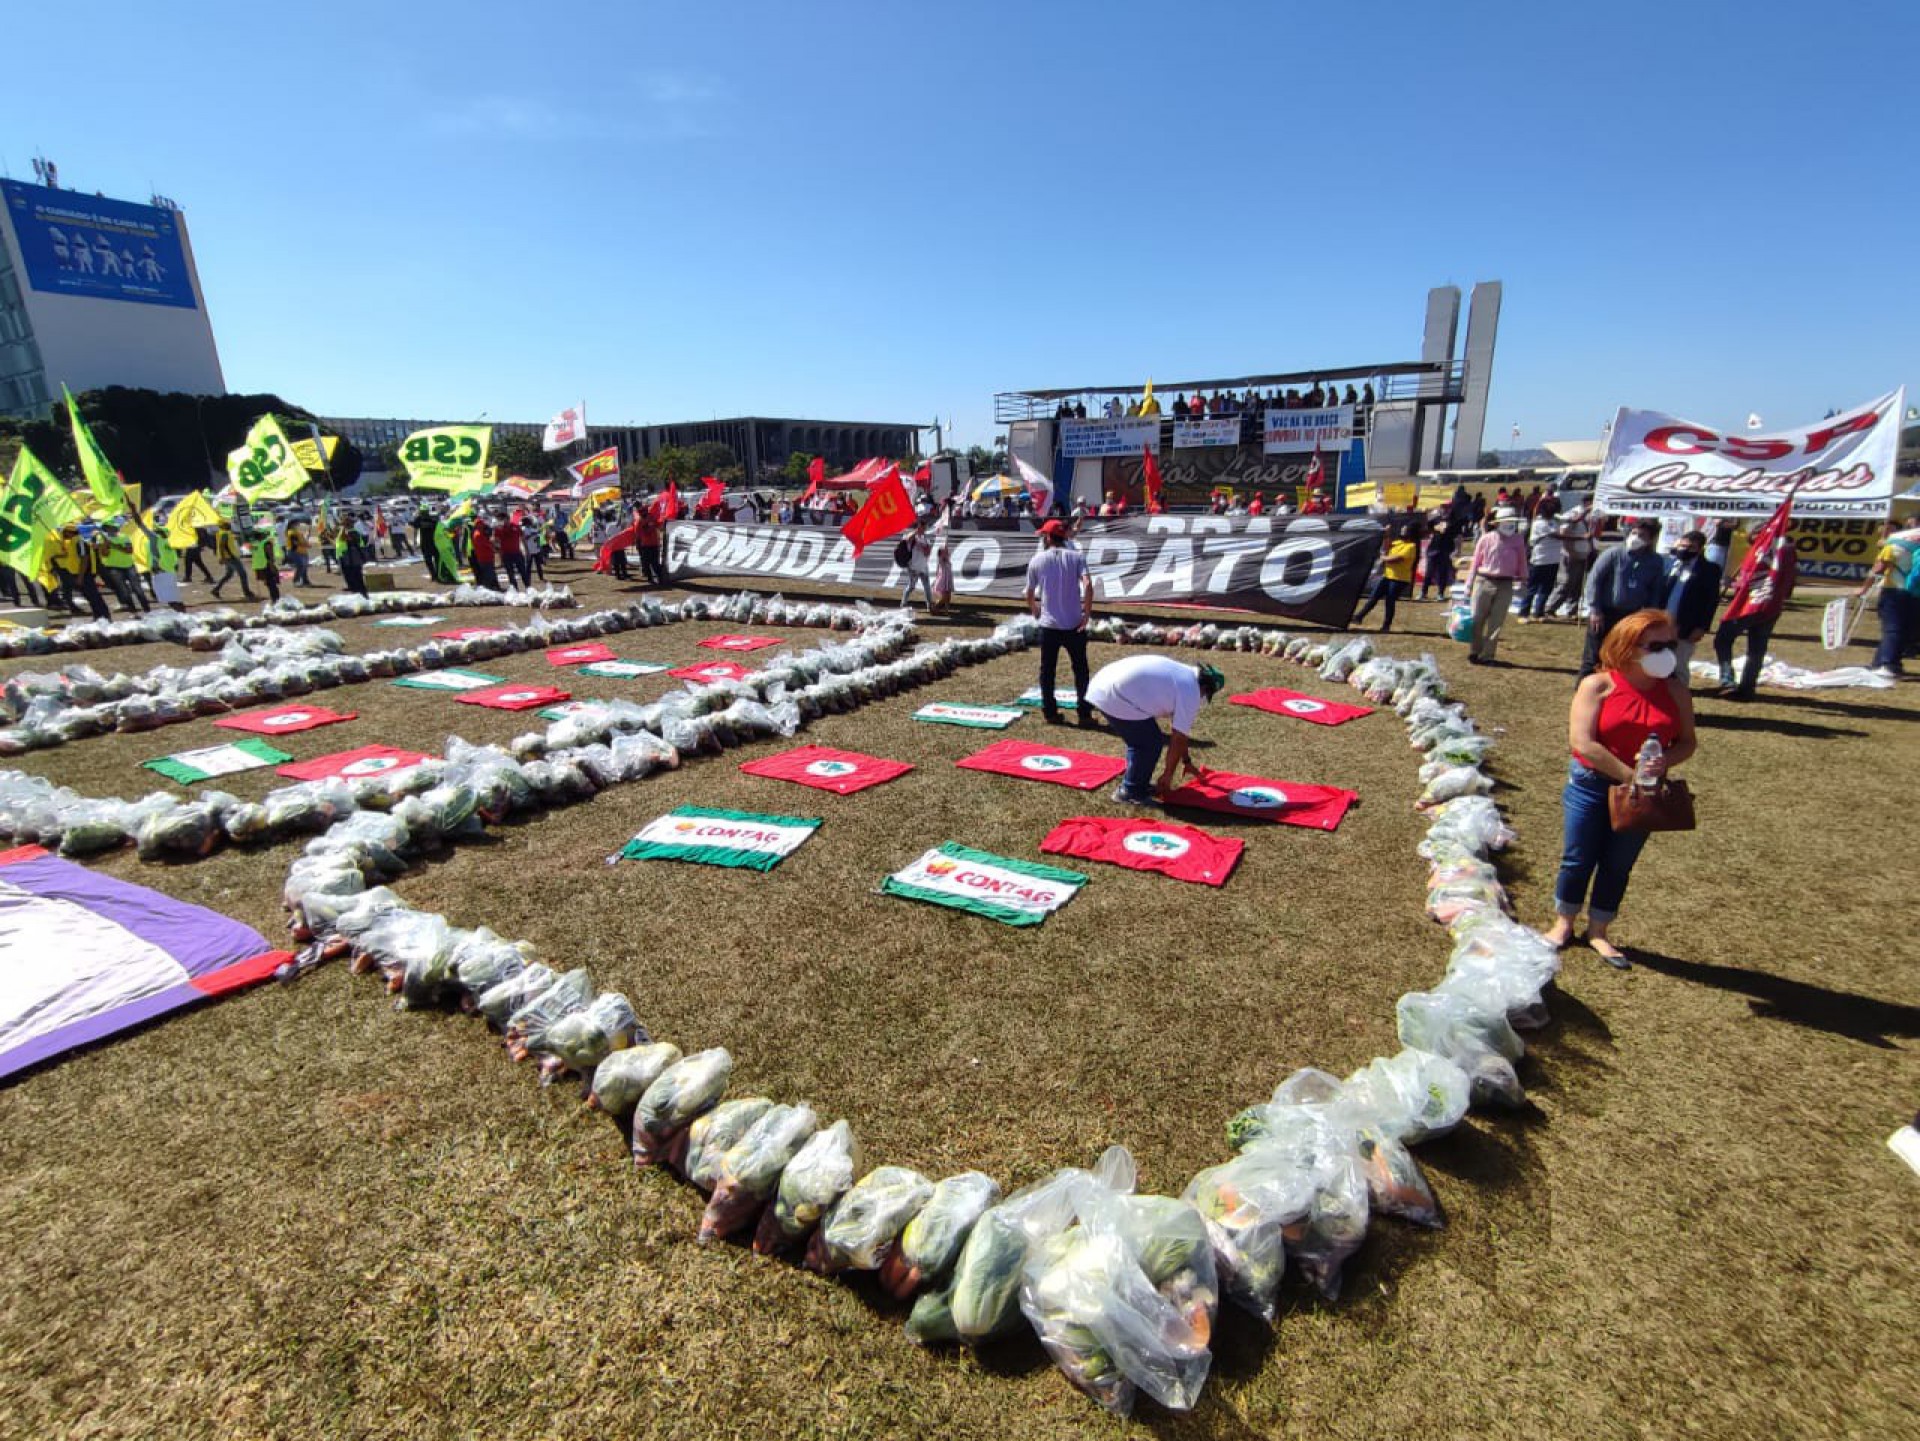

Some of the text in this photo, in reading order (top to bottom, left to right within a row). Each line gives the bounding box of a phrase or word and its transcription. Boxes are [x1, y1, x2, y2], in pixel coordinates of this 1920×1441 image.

[1609, 500, 1682, 511] CENTRAL
[1689, 501, 1769, 512] SINDICAL
[668, 525, 856, 583] COMIDA
[1037, 536, 1334, 605] RATO
[696, 825, 781, 842] CONTAG
[954, 871, 1056, 902] CONTAG
